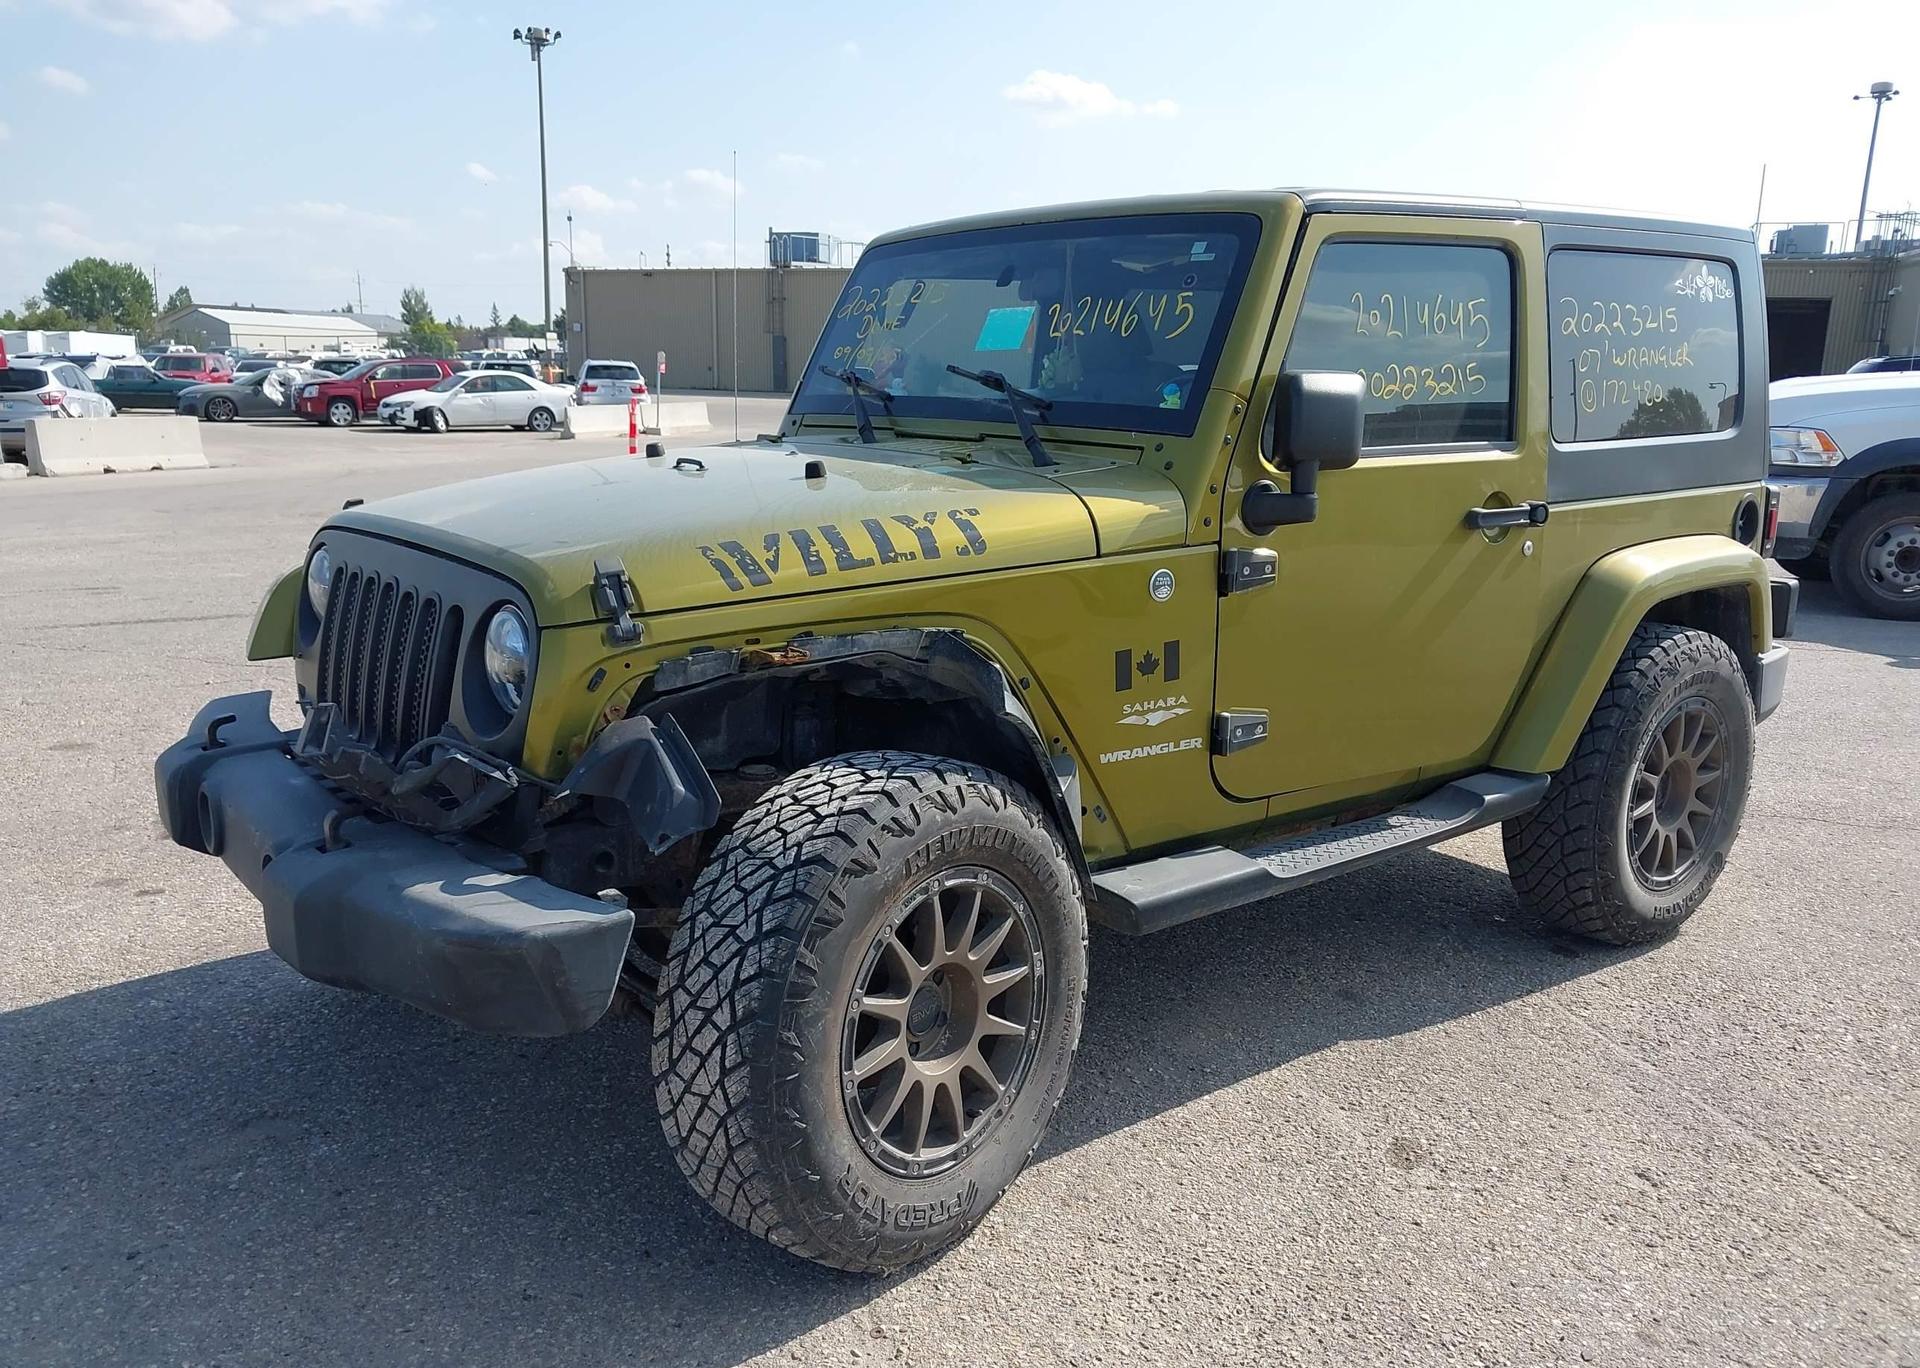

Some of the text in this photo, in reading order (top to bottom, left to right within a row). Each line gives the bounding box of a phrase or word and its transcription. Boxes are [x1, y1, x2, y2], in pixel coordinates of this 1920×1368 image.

[1048, 291, 1194, 339] 20214645
[1351, 292, 1490, 348] 20214645
[1560, 297, 1678, 337] 20223215
[696, 508, 987, 592] WILLYS
[1122, 695, 1188, 714] SAHARA
[1100, 737, 1203, 764] WRANGLER
[836, 1164, 966, 1231] PREDATOR
